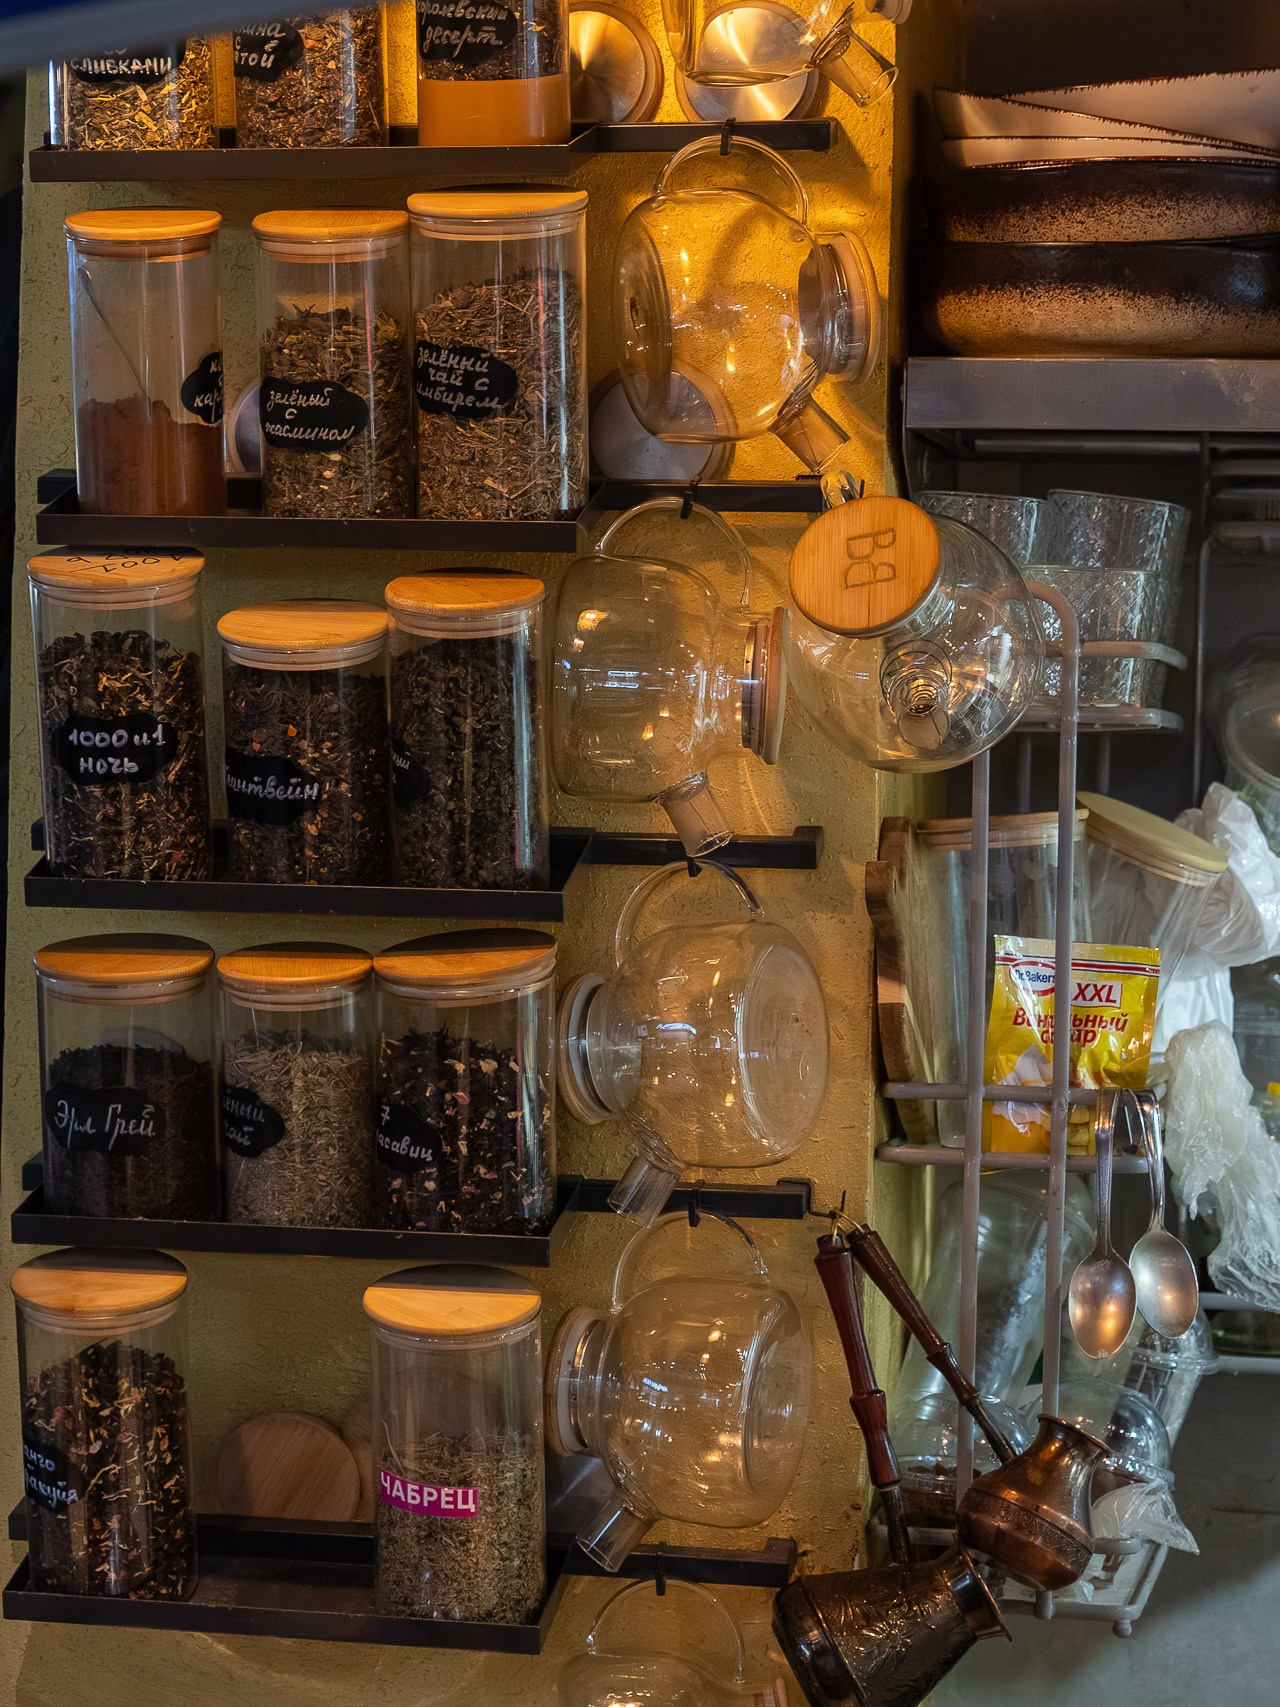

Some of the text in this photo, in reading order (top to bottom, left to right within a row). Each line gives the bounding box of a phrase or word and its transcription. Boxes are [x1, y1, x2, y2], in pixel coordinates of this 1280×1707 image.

[422, 25, 503, 57] десерт
[266, 387, 333, 412] зелёный
[265, 422, 356, 441] жасмином
[68, 728, 129, 748] 1000
[152, 723, 166, 747] 1
[1072, 982, 1118, 1004] XXL
[54, 1099, 157, 1151] Эрл Грей
[380, 1104, 391, 1126] 7
[376, 1128, 433, 1162] асавиц
[381, 1470, 476, 1513] ЧАБРЕЦ
